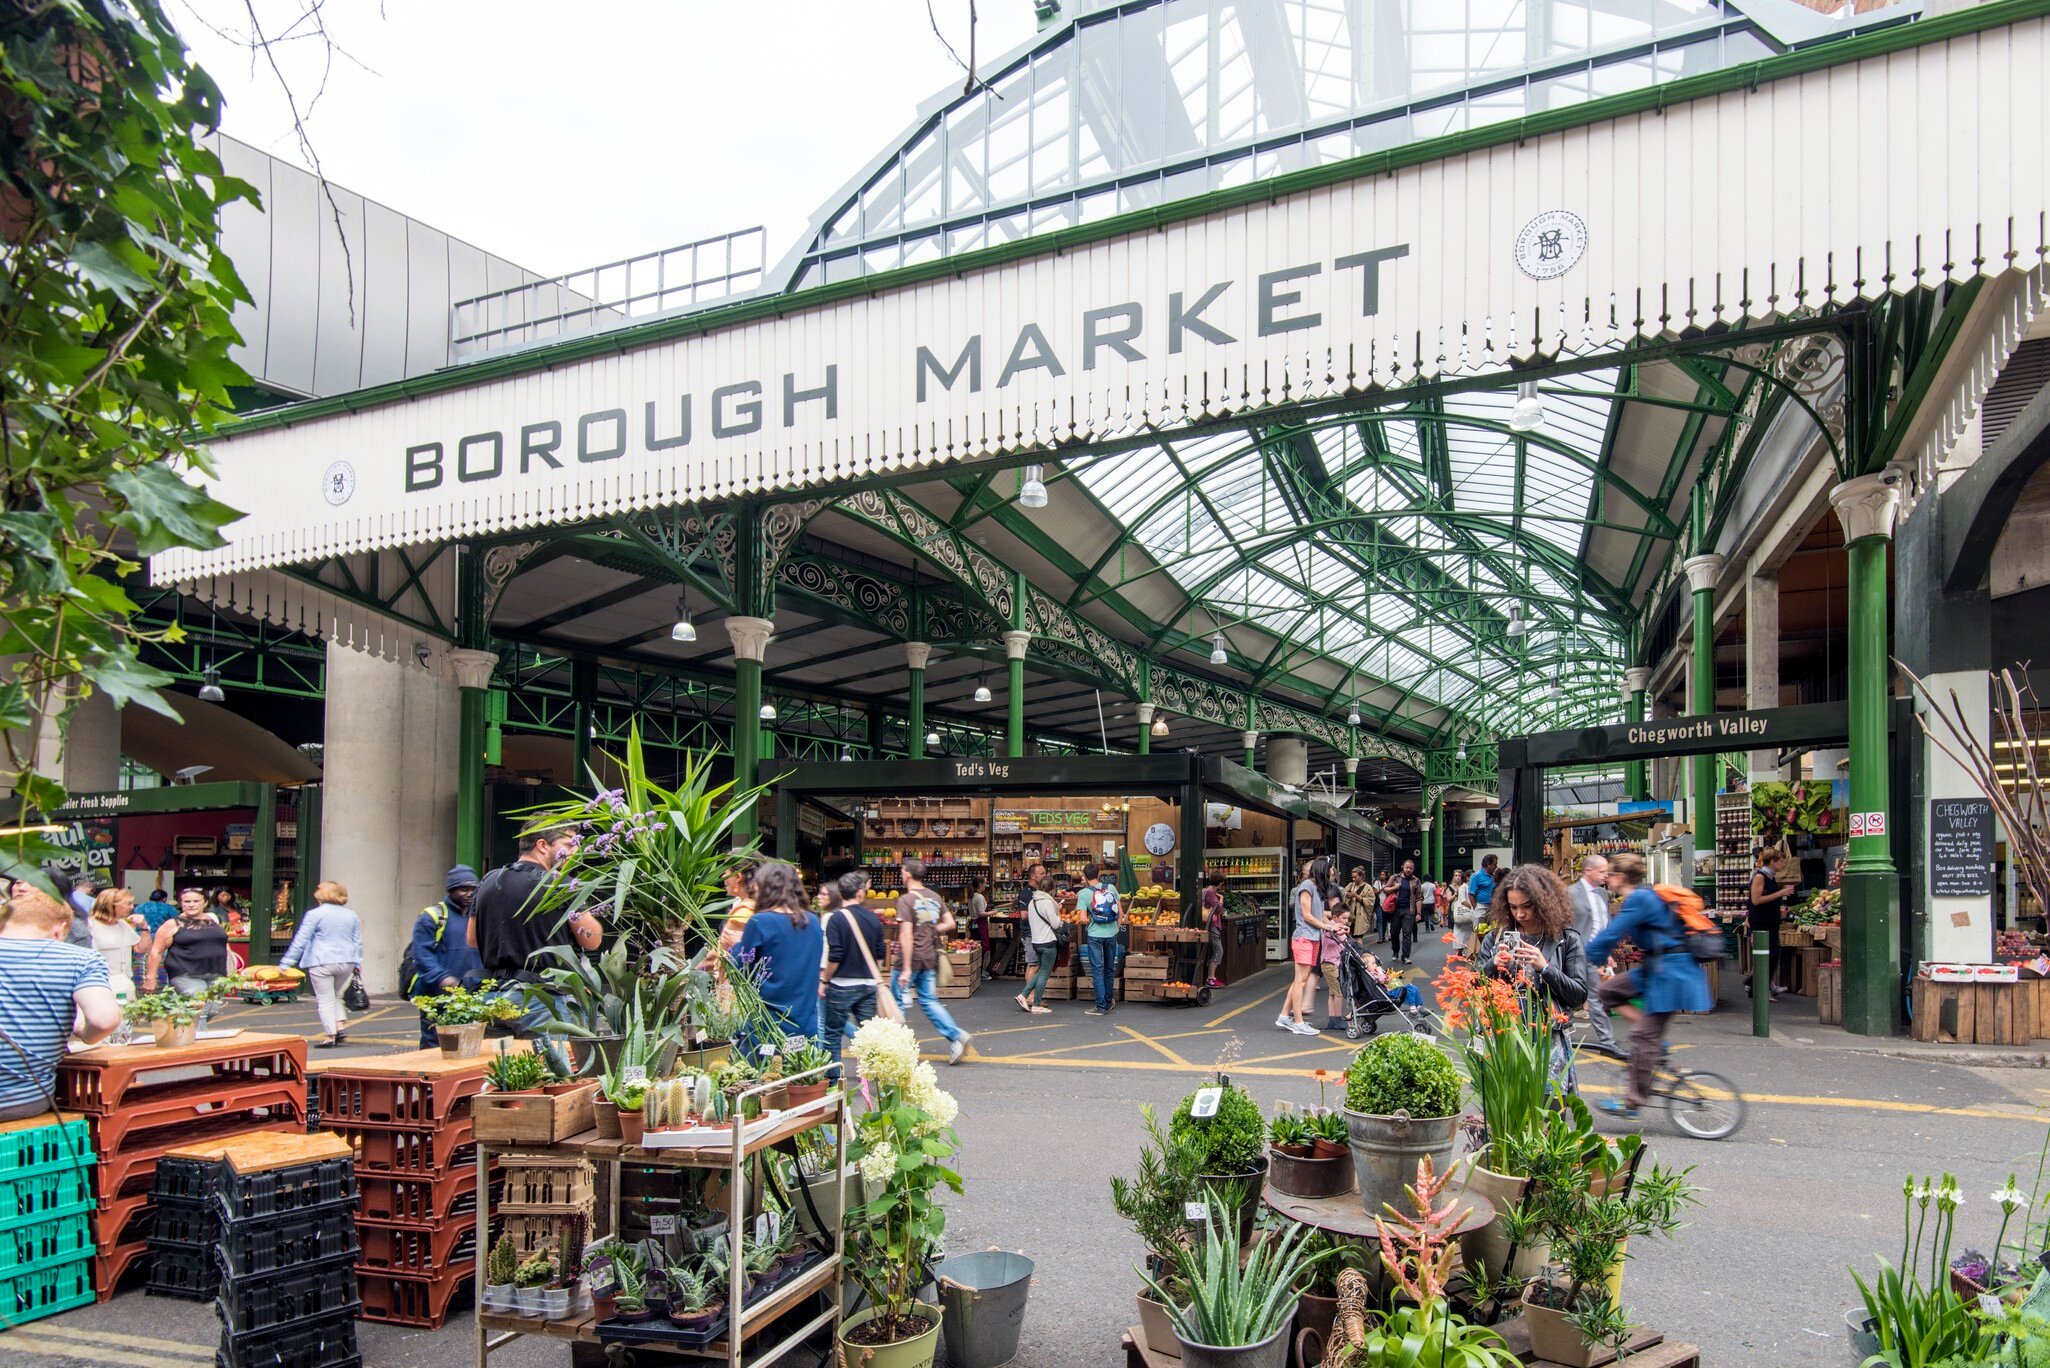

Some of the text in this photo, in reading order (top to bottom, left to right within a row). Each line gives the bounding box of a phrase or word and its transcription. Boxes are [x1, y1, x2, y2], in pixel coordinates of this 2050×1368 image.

[1519, 215, 1583, 260] BOROUGH MARKET
[405, 243, 1410, 493] BOROUGH MARKET
[1628, 717, 1768, 744] Chegworth Valley
[955, 762, 1009, 778] Ted's Veg
[80, 796, 99, 809] Fresh
[100, 794, 129, 809] Supplies
[1936, 803, 1989, 817] CHEGWORTH
[1065, 812, 1090, 824] VEG
[1949, 817, 1978, 829] VALLEY
[42, 821, 86, 847] aul
[1956, 840, 1968, 848] daily
[652, 1217, 674, 1226] 7.50
